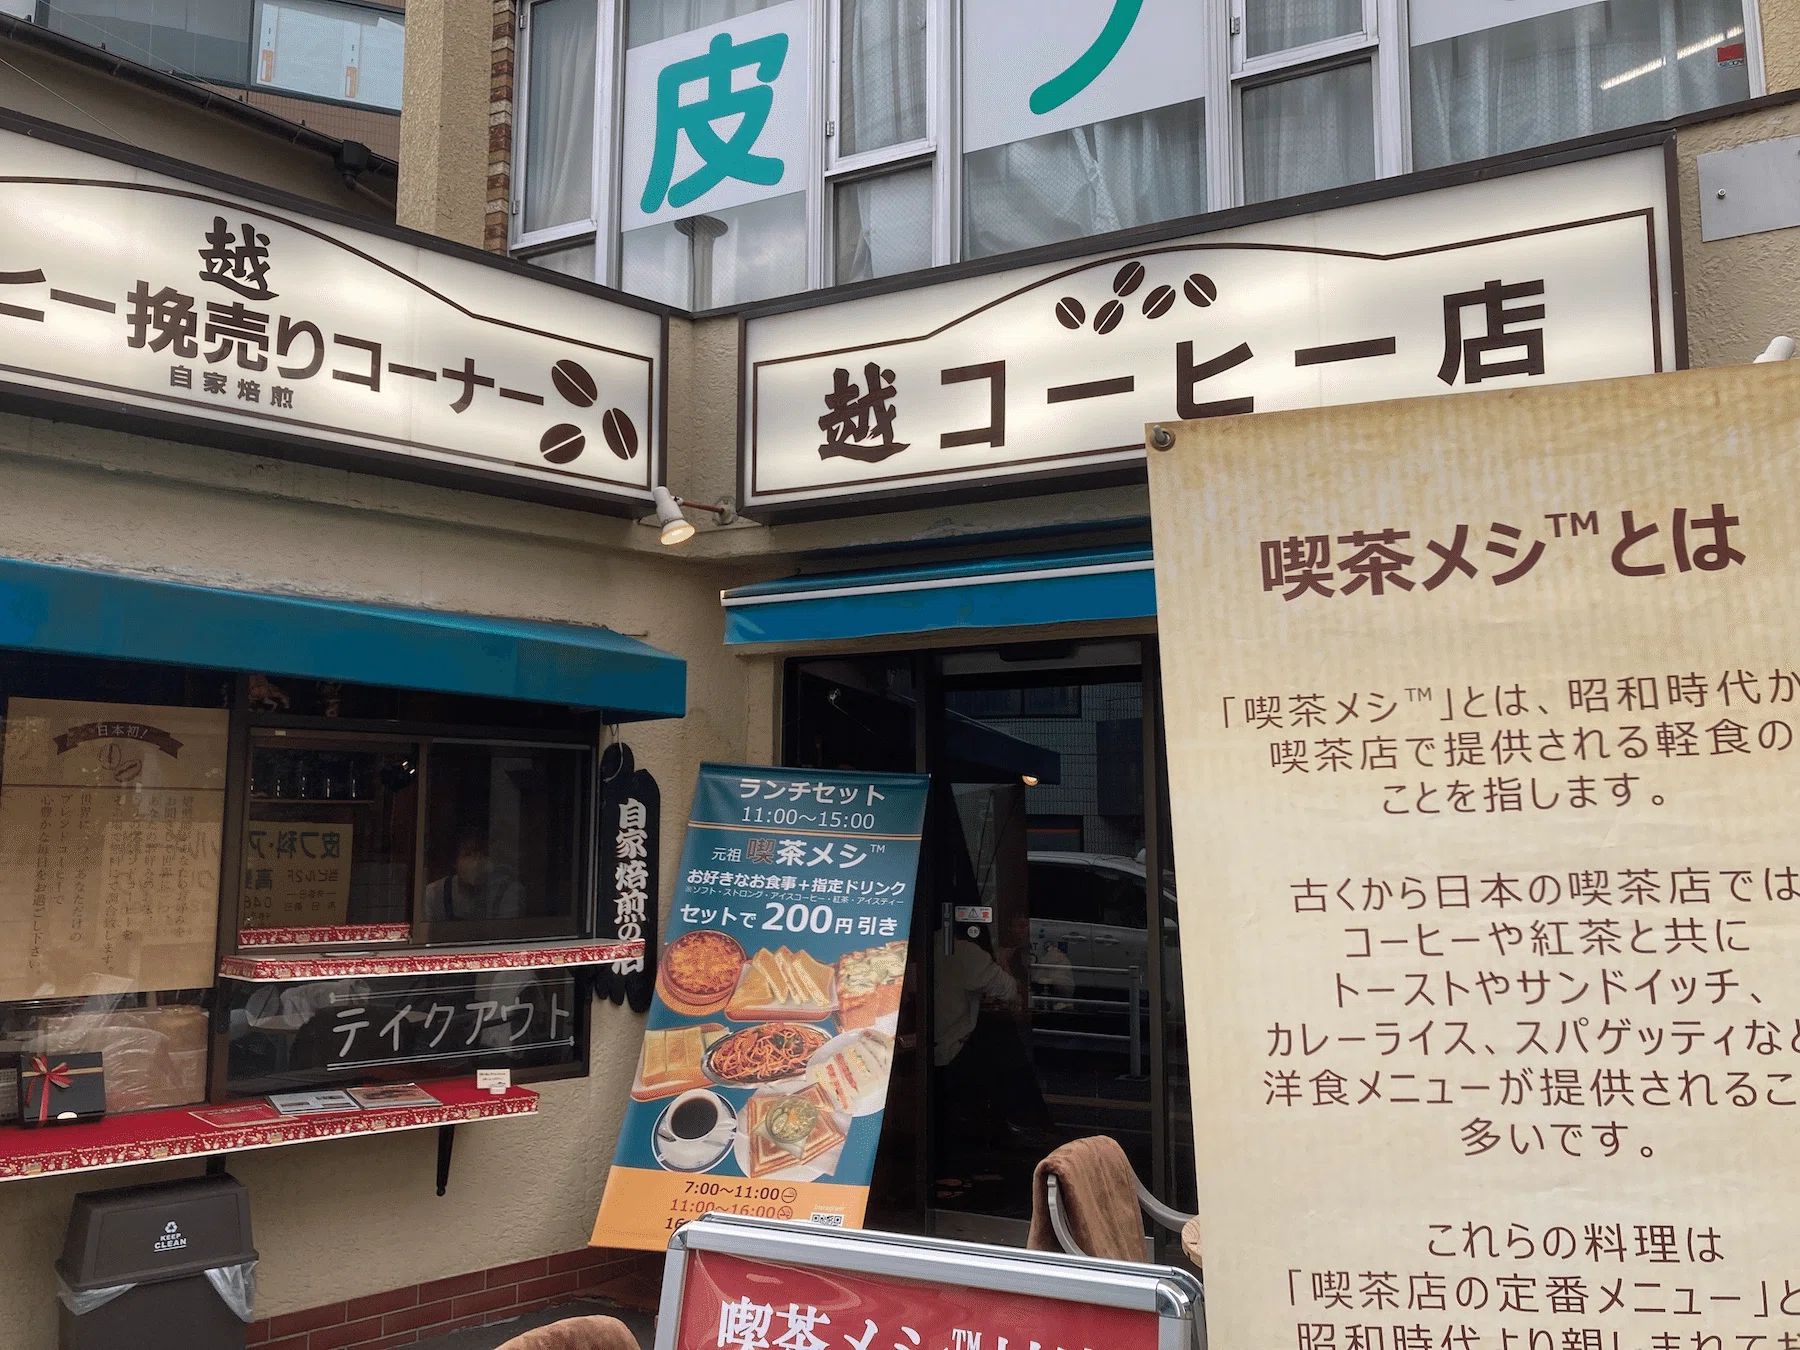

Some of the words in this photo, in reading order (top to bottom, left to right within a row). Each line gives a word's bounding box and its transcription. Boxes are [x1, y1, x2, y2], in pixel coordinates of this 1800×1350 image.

[640, 33, 790, 214] 皮
[198, 216, 280, 300] 越
[169, 364, 295, 410] 自家焙煎
[818, 279, 1547, 462] 越コーヒー店
[1269, 718, 1794, 775] 喫茶店で提供される軽食の
[739, 778, 886, 807] ランチセット
[1381, 772, 1666, 815] ことを指します。
[741, 806, 876, 830] 11:00〜15:00
[711, 847, 741, 863] 元祖
[1290, 866, 1800, 914] 古くから日本の喫茶店では
[1344, 917, 1751, 959] コーヒーや紅茶と共に
[1335, 968, 1762, 1008] トーストやサンドイッチ、
[332, 993, 570, 1058] テイクアウト
[1263, 1067, 1797, 1109] 洋食メニューが提供されるこ
[1461, 1117, 1654, 1159] 多いです。
[154, 1238, 187, 1250] CLEAN
[160, 1232, 182, 1242] KEEP
[1427, 1222, 1725, 1264] これらの料理は
